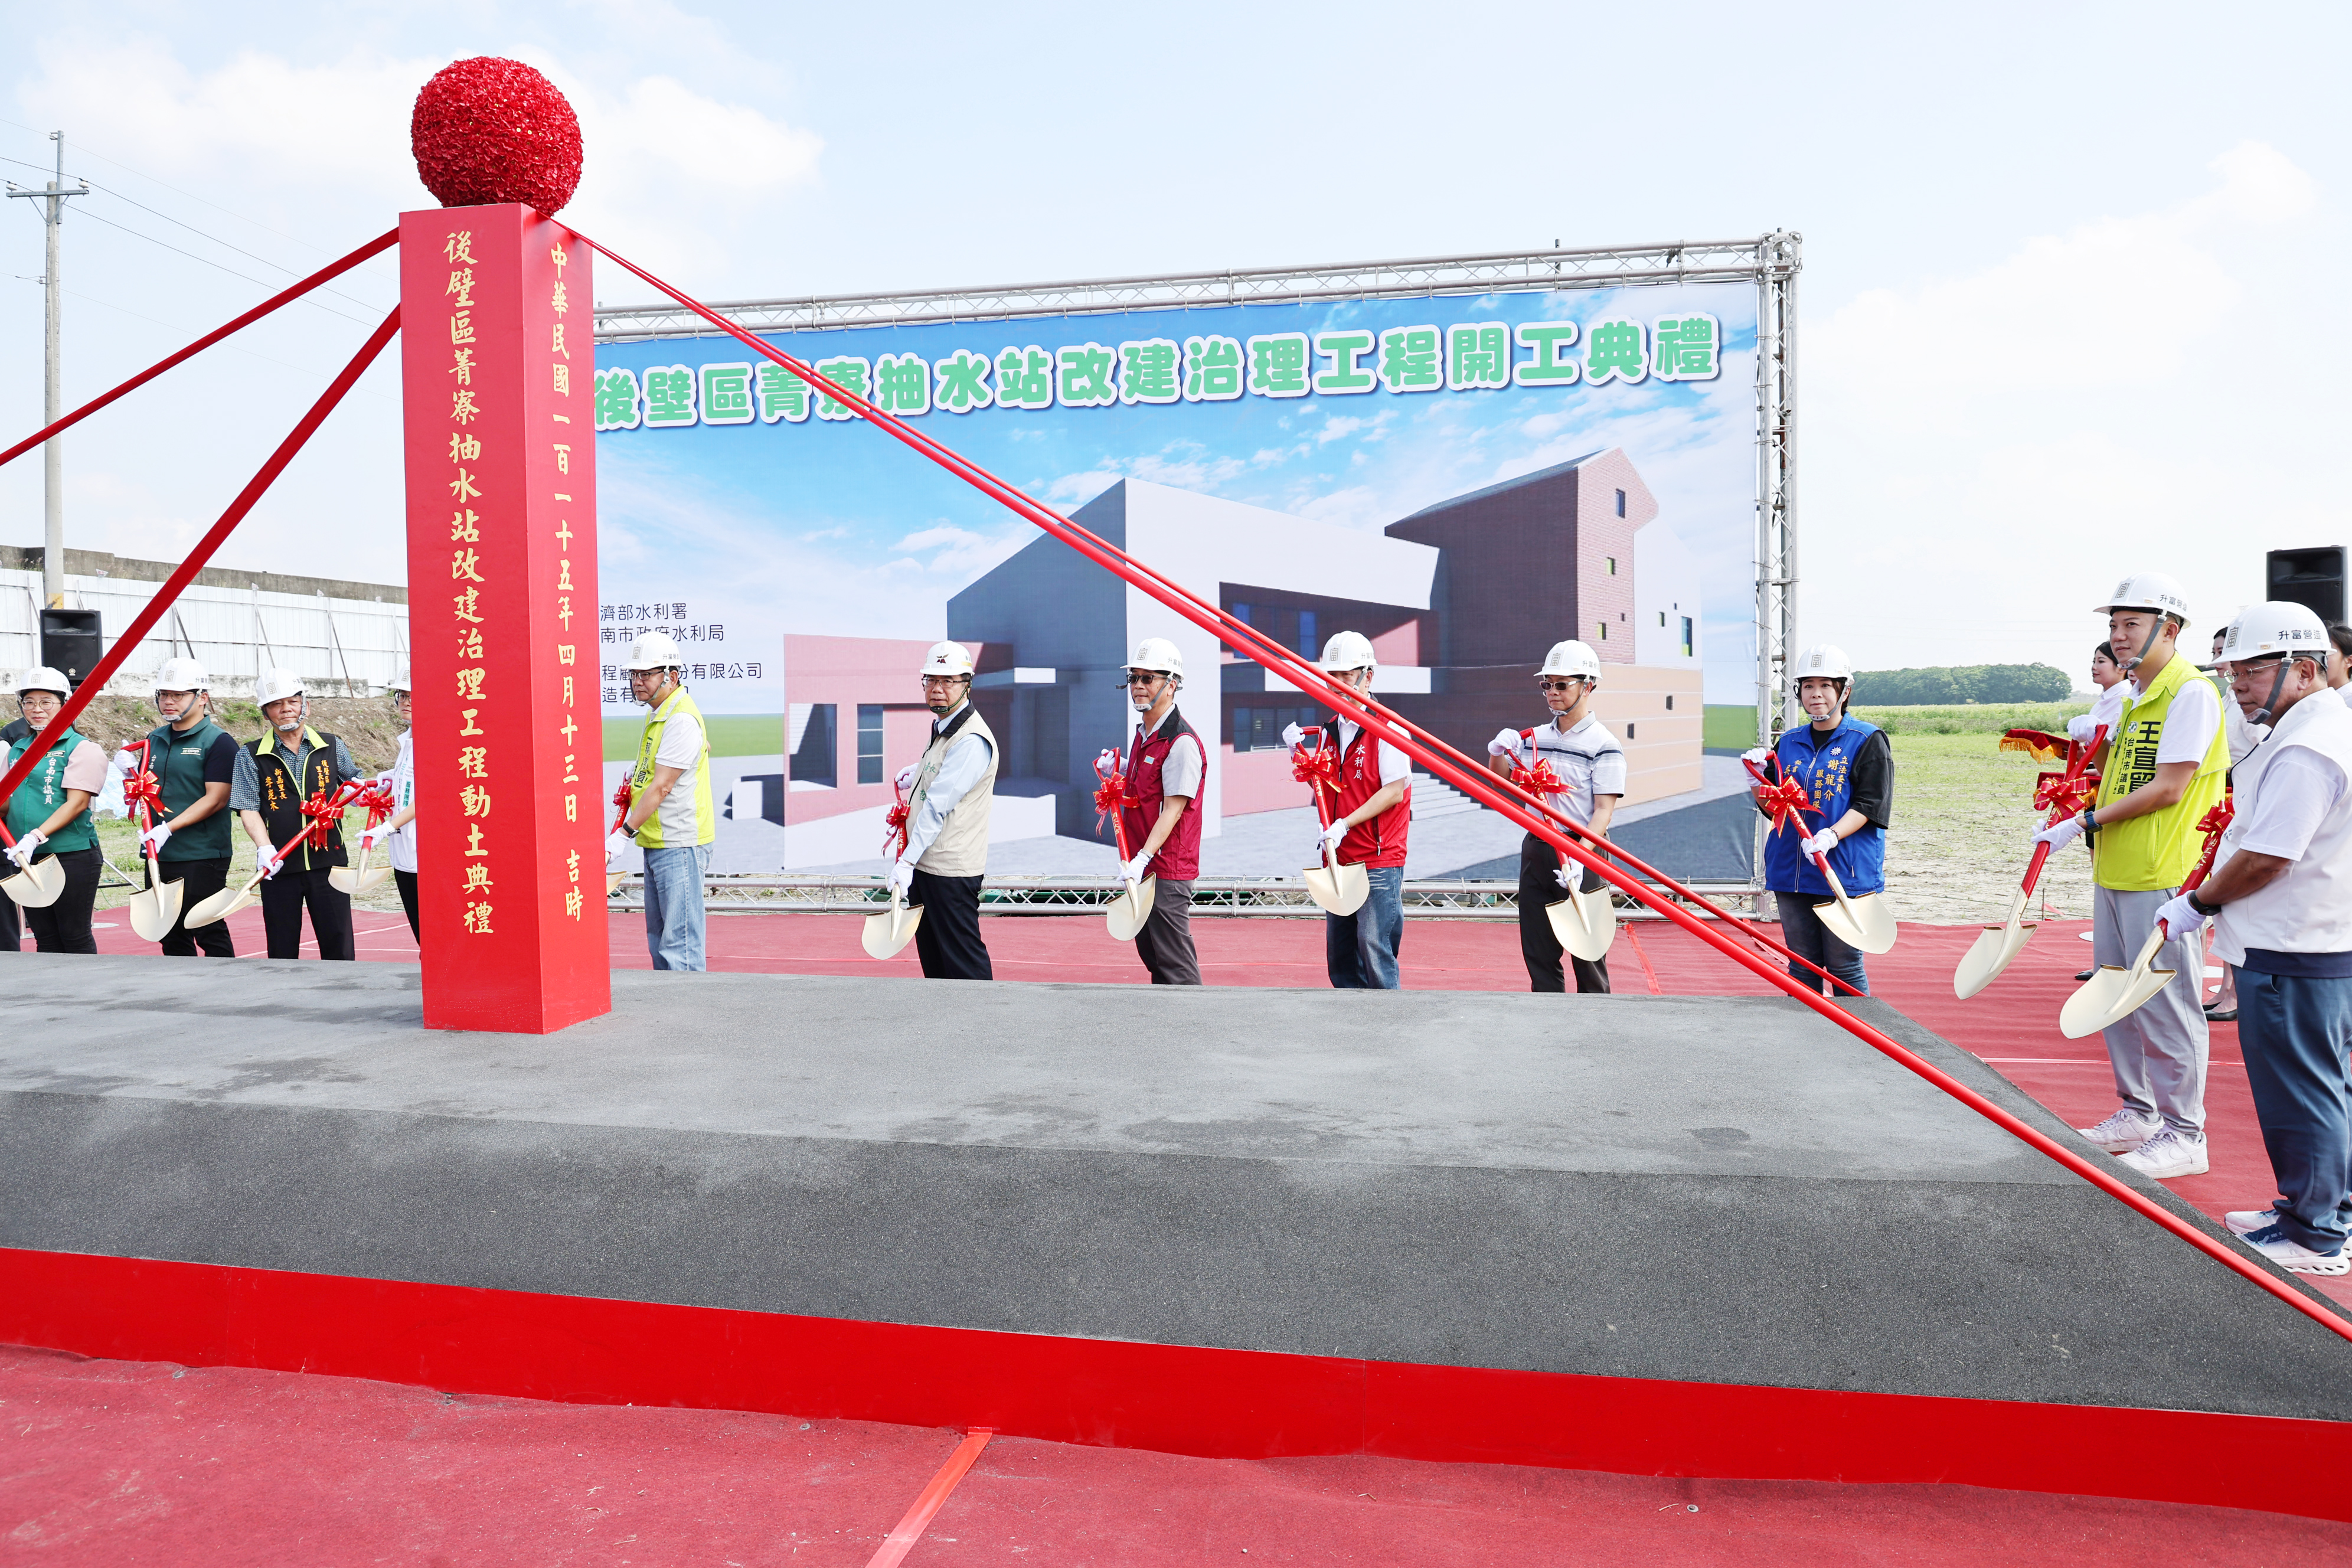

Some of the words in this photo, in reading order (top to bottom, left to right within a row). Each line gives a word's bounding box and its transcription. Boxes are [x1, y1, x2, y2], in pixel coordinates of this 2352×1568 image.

[594, 315, 1717, 428] 後壁區菁寮抽水站改建治理工程開工典禮
[550, 242, 580, 824] 中華民國一百一十五年四月十三日
[443, 230, 494, 934] 後壁區菁寮抽水站改建治理工程動土典禮
[600, 603, 687, 622] 濟部水利署
[2278, 629, 2321, 641] 升富營造
[602, 662, 762, 682] 程份有限公司
[43, 757, 57, 805] 台南市議員
[1353, 744, 1366, 780] 水利局
[1823, 759, 1840, 802] 謝龍介
[1835, 756, 1848, 795] 立法委員
[2116, 737, 2135, 795] 台南市議員
[1812, 769, 1825, 809] 服務團隊
[564, 848, 584, 922] 吉時
